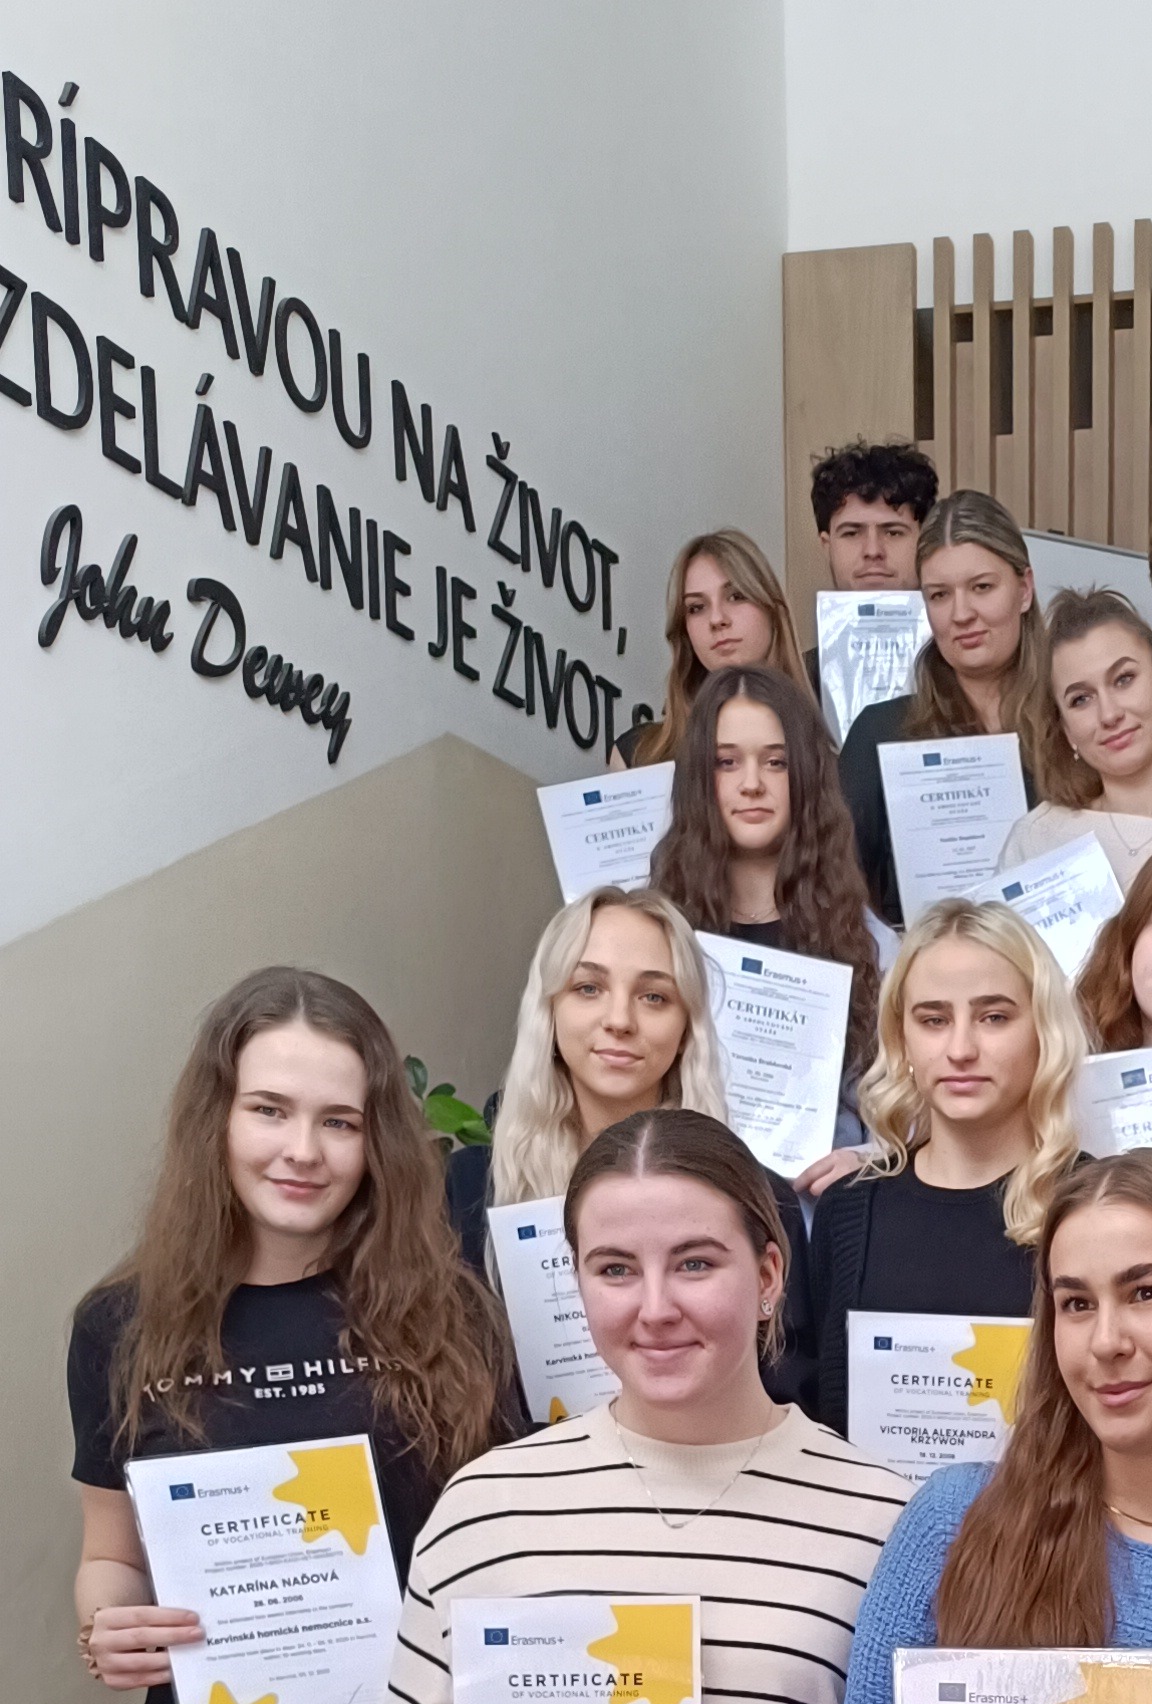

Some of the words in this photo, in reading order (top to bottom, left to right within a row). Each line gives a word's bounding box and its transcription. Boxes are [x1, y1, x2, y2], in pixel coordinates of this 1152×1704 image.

[0, 71, 372, 449] RÍPRAVOU
[392, 380, 476, 533] NA
[487, 431, 627, 654] ŽIVOT,
[0, 265, 415, 640] ZDELÁVANIE
[429, 566, 480, 681] JE
[492, 581, 622, 765] ŽIVOT
[38, 504, 173, 652] John
[187, 578, 352, 764] Dewey
[943, 756, 981, 766] Erasmus+
[920, 787, 990, 803] CERTIFIKÁT
[585, 821, 655, 844] CERTIFIKÁT
[764, 968, 807, 985] Erasmus+
[728, 999, 808, 1025] CERTIFIKÁT
[539, 1228, 563, 1237] Erasm
[554, 1311, 587, 1323] NIKOL
[895, 1344, 935, 1353] Erasmus+
[143, 1367, 256, 1402] TOMMY
[304, 1357, 400, 1377] HILFI
[891, 1374, 993, 1389] CERTIFICATE
[254, 1388, 286, 1399] EST.
[292, 1384, 325, 1396] 1985
[880, 1425, 929, 1436] VICTORIA
[932, 1428, 996, 1439] ALEXANDRA
[198, 1485, 250, 1498] Erasmus+
[201, 1509, 331, 1536] CERTIFICATE
[208, 1538, 220, 1546] OF
[223, 1530, 284, 1545] VOCATIONAL
[210, 1576, 279, 1598] KATARÍNA
[281, 1569, 339, 1588] NAĎOVÁ
[511, 1636, 564, 1645] Erasmus+
[509, 1673, 643, 1687] CERTIFICATE
[528, 1690, 589, 1698] VOCATIONAL
[595, 1690, 639, 1698] TRAINING
[969, 1692, 1028, 1704] Erasmus+
